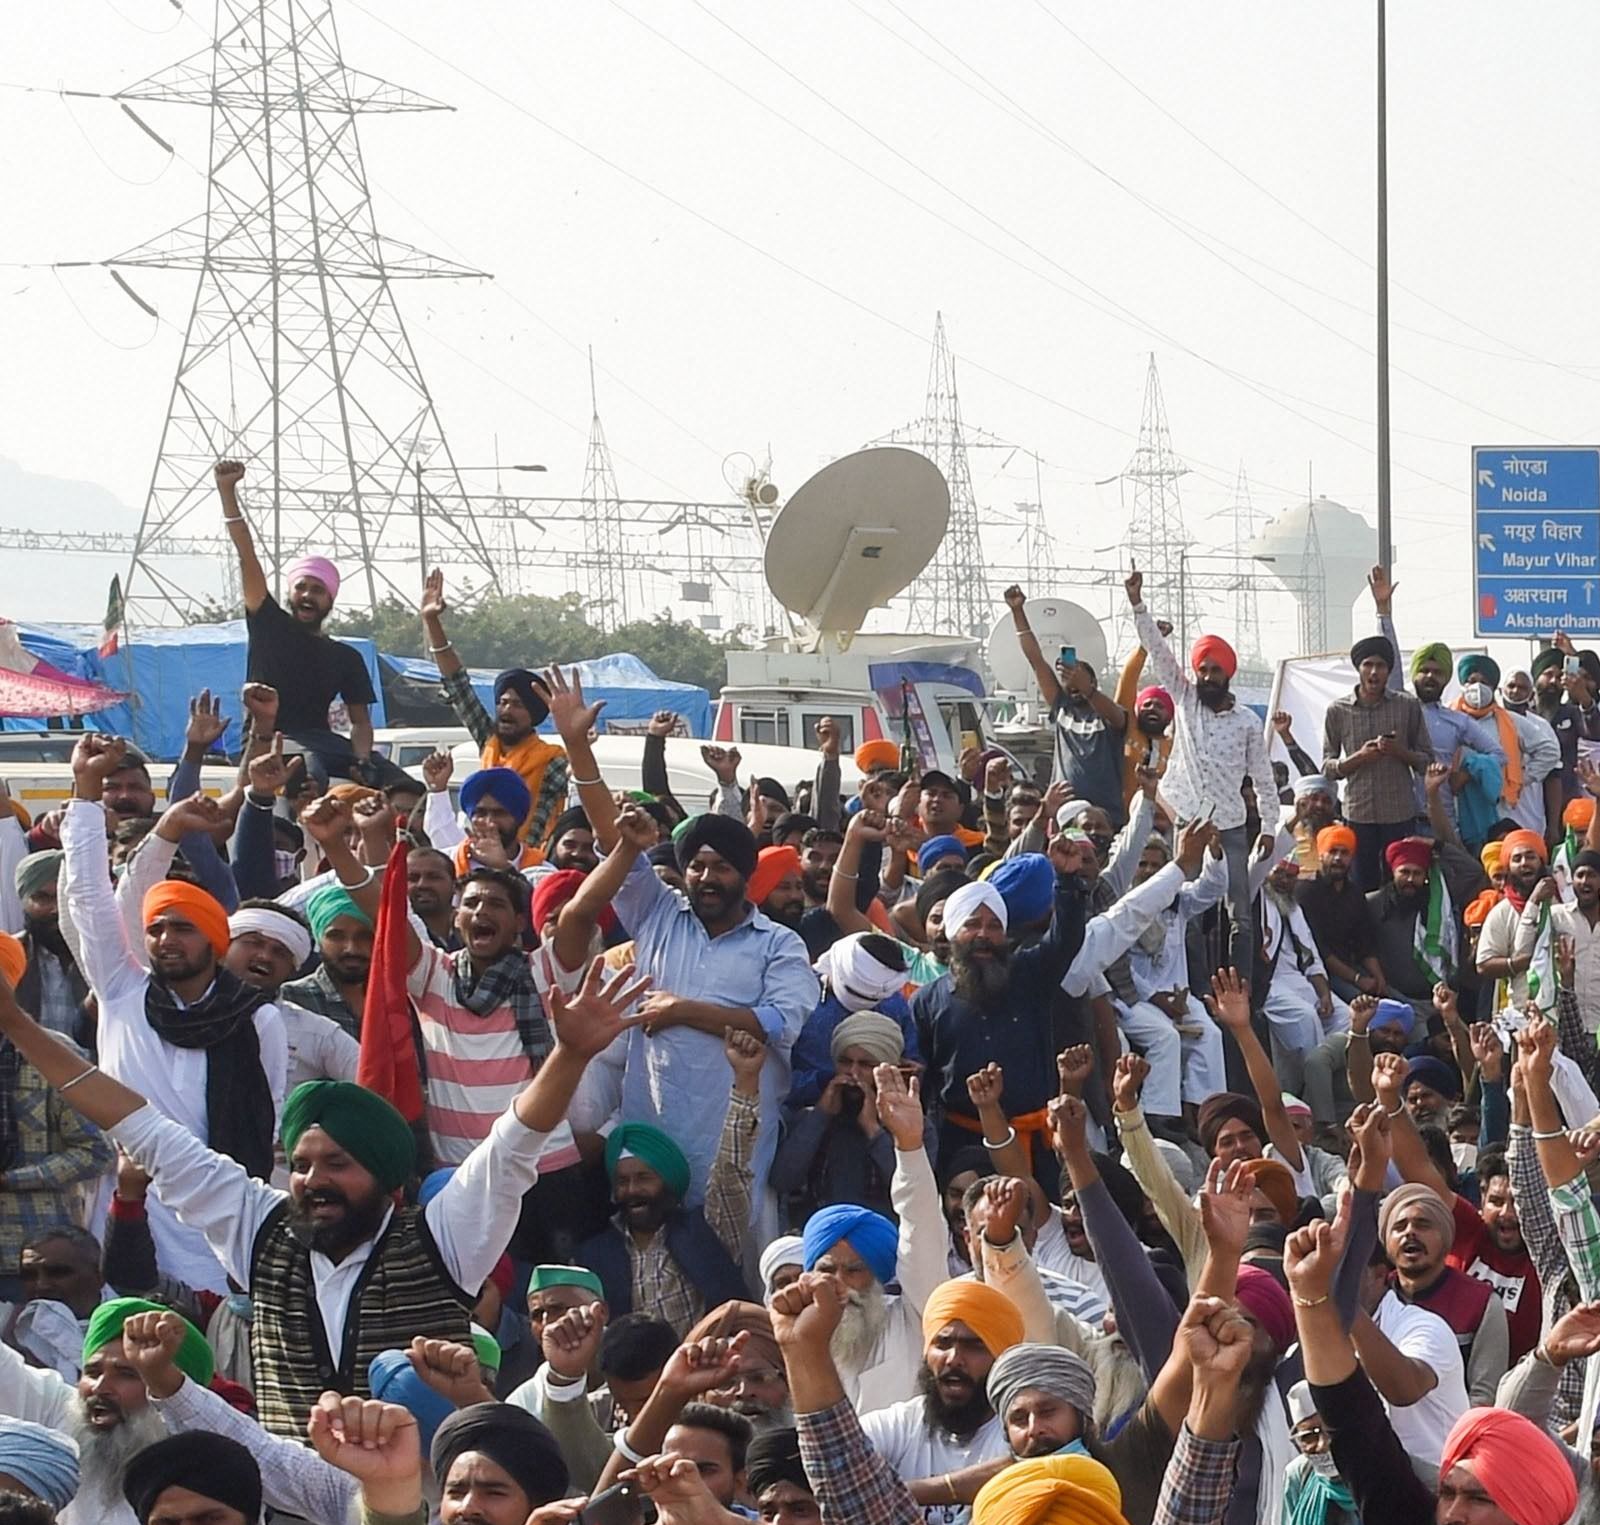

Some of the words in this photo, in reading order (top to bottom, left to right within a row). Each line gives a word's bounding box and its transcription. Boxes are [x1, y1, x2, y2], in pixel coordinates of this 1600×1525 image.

[1502, 455, 1548, 477] नोएडा
[1502, 487, 1547, 502] Noida
[1503, 524, 1536, 543] मयूर
[1542, 519, 1583, 541] विहार
[1503, 552, 1551, 571] Mayur
[1554, 552, 1597, 567] Vihar
[1503, 587, 1568, 604] अक्षरधाम
[1504, 614, 1600, 629] Akshardham
